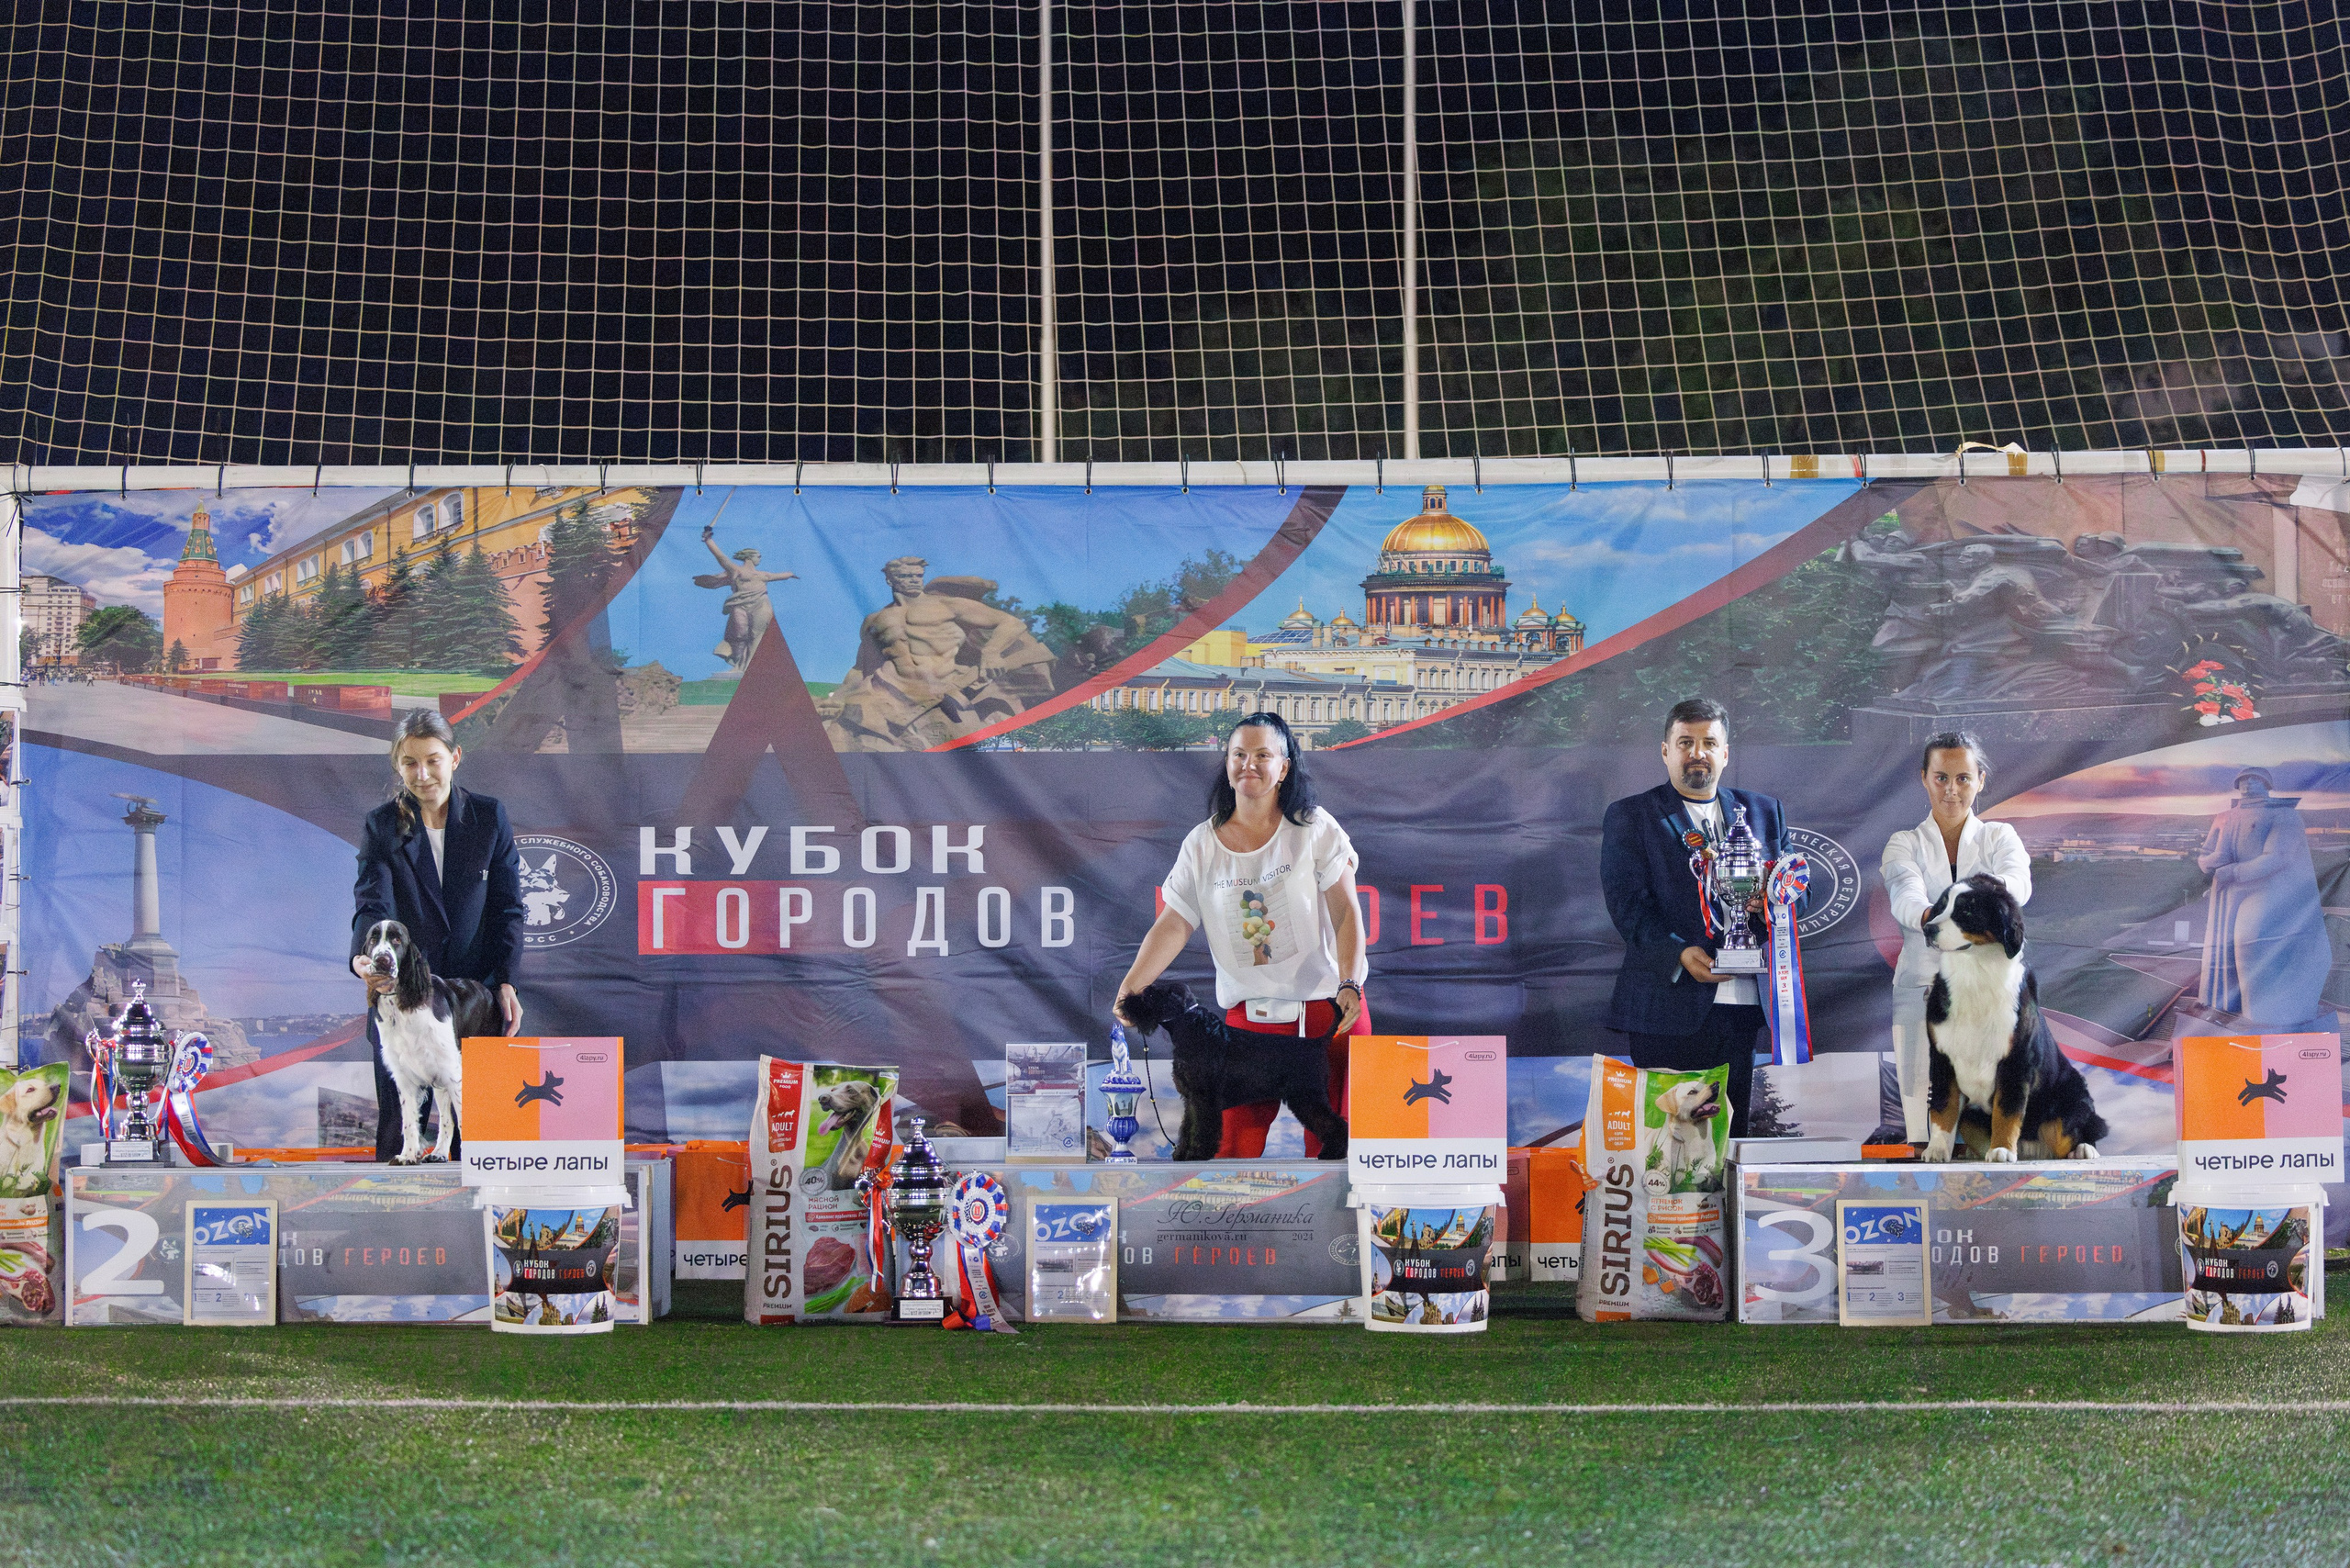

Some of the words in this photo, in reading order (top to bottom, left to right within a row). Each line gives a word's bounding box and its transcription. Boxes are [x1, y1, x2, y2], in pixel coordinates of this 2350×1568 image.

[638, 825, 988, 876] КУБОК
[1788, 832, 1851, 870] ИЧЕСКАЯ
[520, 837, 592, 861] СЛУЖЕБНОГО
[584, 860, 610, 926] СОБАКОВОДСТВА
[1214, 880, 1225, 890] THE
[1226, 878, 1260, 888] MUSEUM
[1262, 864, 1292, 882] VISITOR
[1799, 877, 1854, 933] ФЕДЕРАЦИ
[651, 886, 1075, 957] ГОРОДОВ
[524, 935, 556, 943] ФСС
[1607, 1076, 1632, 1084] PREMIUM
[771, 1122, 794, 1132] ADULT
[1607, 1120, 1631, 1131] ADULT
[470, 1156, 548, 1170] четыре
[554, 1156, 608, 1170] лапы
[1359, 1154, 1438, 1169] четыре
[1442, 1154, 1497, 1169] лапы
[2195, 1154, 2274, 1170] четыре
[2279, 1152, 2334, 1169] лапы
[804, 1175, 824, 1185] 40%
[1648, 1179, 1666, 1187] 44%
[808, 1194, 840, 1203] МЯСНОЙ
[808, 1203, 838, 1211] РАЦИОН
[194, 1208, 270, 1245] OZON
[763, 1164, 793, 1299] SIRIUS
[1600, 1164, 1634, 1296] SIRIUS
[1845, 1208, 1921, 1244] OZON
[80, 1209, 164, 1294] 2
[344, 1247, 447, 1266] ГЕРОЕВ
[1174, 1246, 1276, 1266] ГЕРОЕВ
[1756, 1209, 1835, 1303] 3
[1931, 1246, 1999, 1266] ОДОВ
[2020, 1246, 2123, 1264] ГЕРОЕВ
[523, 1259, 549, 1268] КУБОК
[683, 1254, 748, 1266] четыре
[1404, 1259, 1430, 1267] КУБОК
[1492, 1255, 1521, 1268] апы
[2205, 1257, 2228, 1267] КУБОК
[524, 1268, 555, 1280] ГОРОДОВ
[1404, 1267, 1437, 1279] ГОРОДОВ
[2205, 1266, 2234, 1279] ГОРОДОВ
[216, 1293, 221, 1302] 2
[1057, 1291, 1064, 1299] 2
[1869, 1292, 1875, 1302] 2
[1897, 1292, 1905, 1302] 3
[1598, 1299, 1629, 1307] PREMIUM
